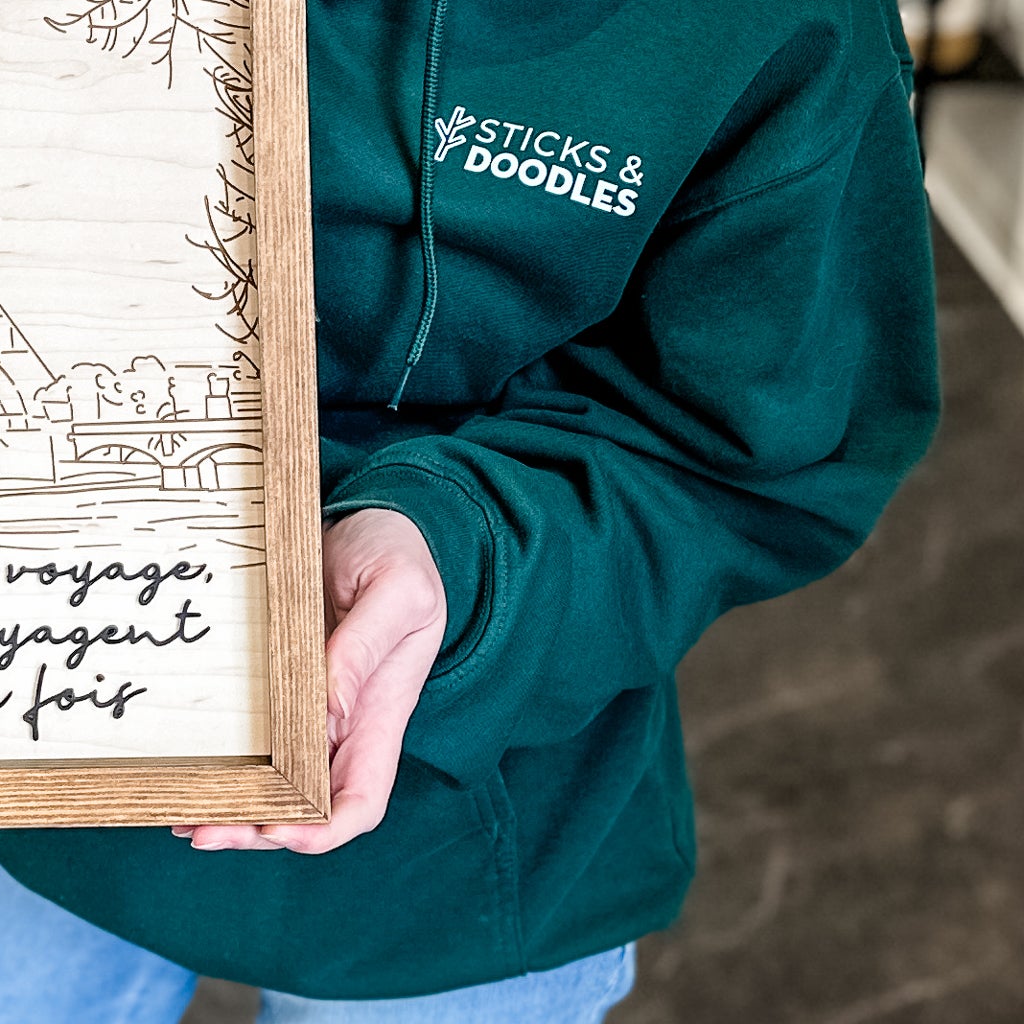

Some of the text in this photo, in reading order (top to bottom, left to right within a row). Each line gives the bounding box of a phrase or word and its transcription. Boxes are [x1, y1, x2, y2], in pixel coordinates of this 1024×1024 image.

[463, 144, 639, 217] DOODLES
[475, 118, 644, 187] STICKS &
[6, 560, 214, 608] voyage,
[21, 663, 149, 742] fois
